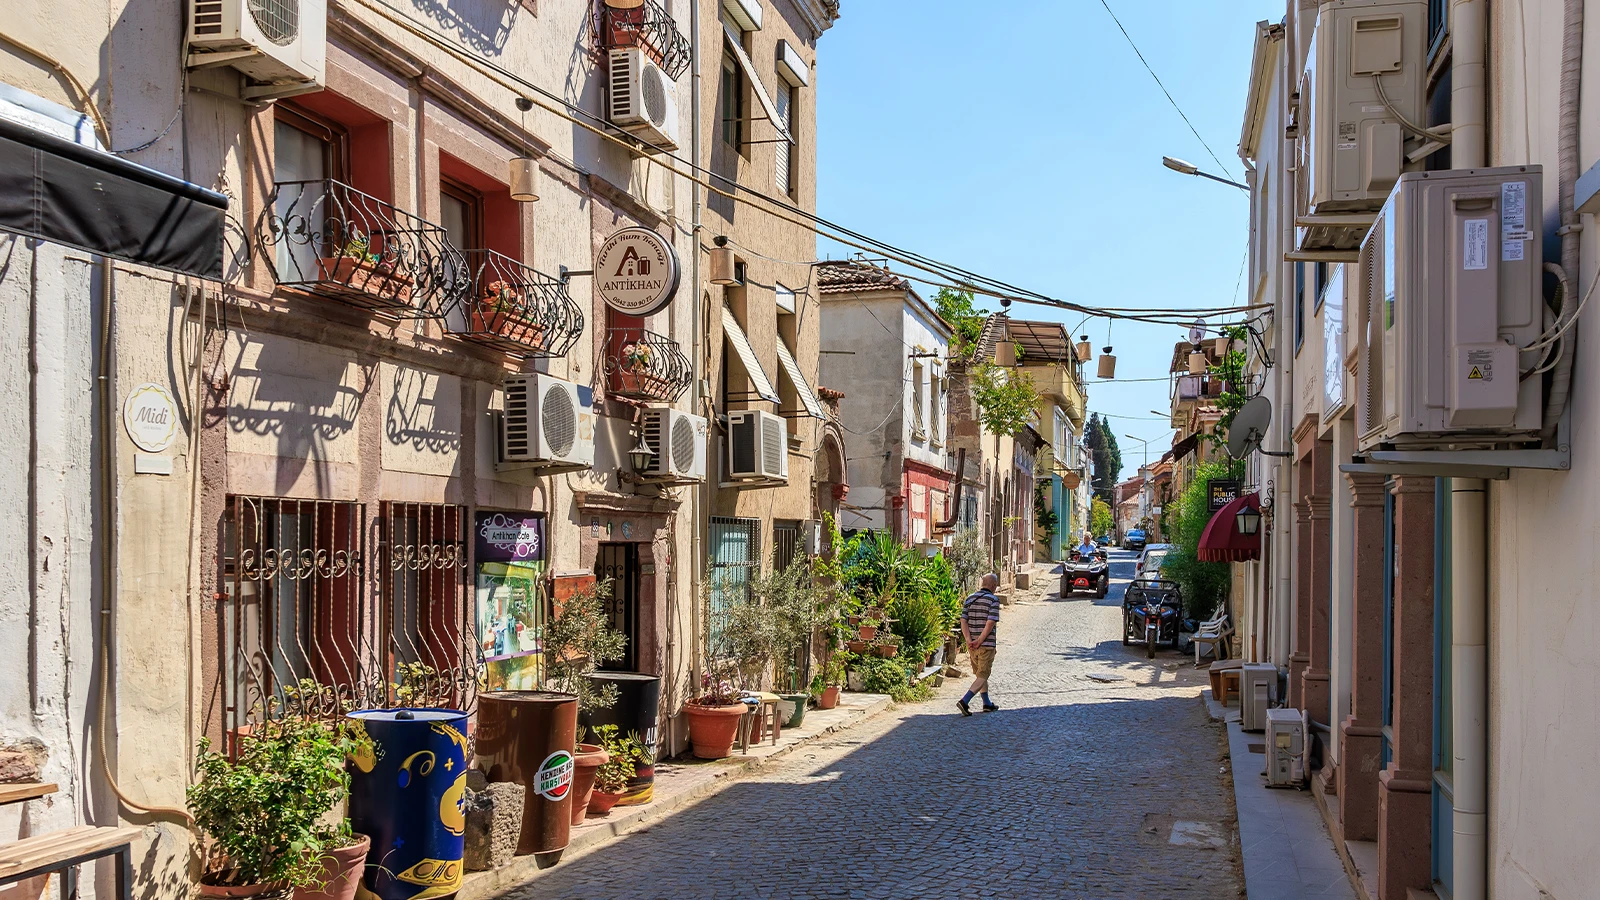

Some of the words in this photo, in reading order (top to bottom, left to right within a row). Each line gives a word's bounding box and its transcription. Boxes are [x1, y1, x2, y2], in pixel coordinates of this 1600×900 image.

[603, 278, 662, 291] ANTİKHAN
[135, 406, 169, 425] Midi
[517, 531, 530, 540] Cafe
